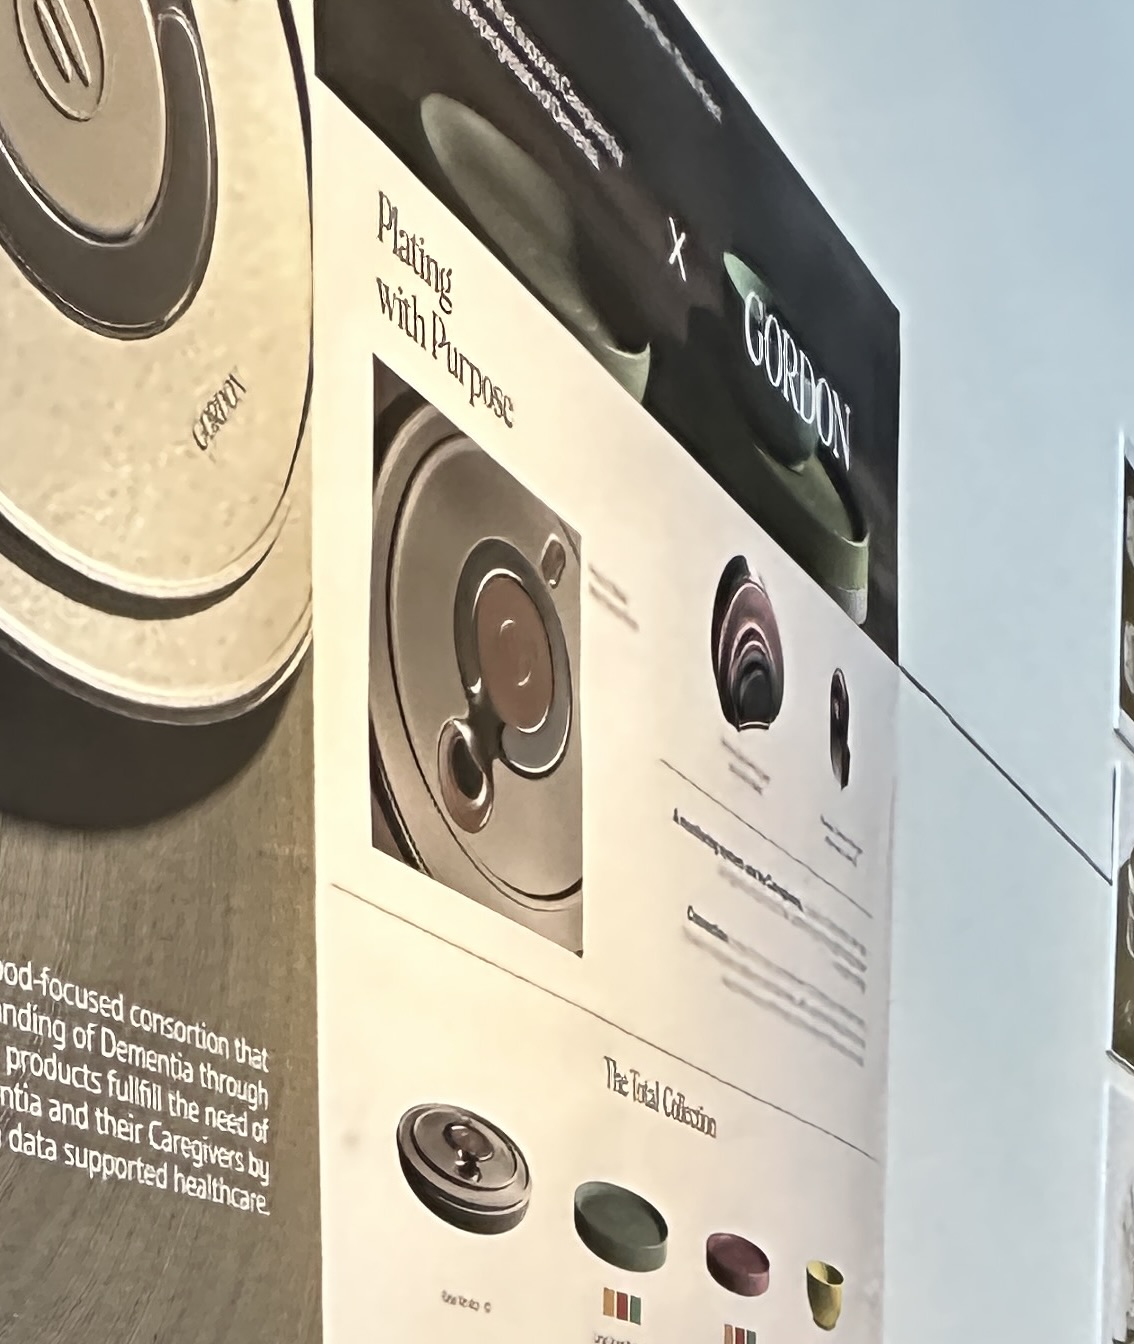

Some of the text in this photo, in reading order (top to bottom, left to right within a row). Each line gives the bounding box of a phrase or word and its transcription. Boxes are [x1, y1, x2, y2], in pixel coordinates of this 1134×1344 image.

[377, 190, 453, 315] Plating
[376, 276, 515, 429] with Purpose
[744, 291, 851, 472] GORDON
[0, 960, 269, 1074] od-focused consortion that
[0, 1001, 269, 1112] nding of Dementia through
[6, 1045, 103, 1095] products
[168, 1090, 200, 1124] the
[204, 1106, 249, 1138] need
[252, 1117, 270, 1145] of
[49, 1098, 89, 1131] and
[95, 1107, 144, 1144] their
[148, 1120, 245, 1173] Caregivers
[248, 1149, 270, 1188] by
[604, 1055, 717, 1139] The Total Collection
[9, 1122, 57, 1162] data
[62, 1142, 168, 1190] supported
